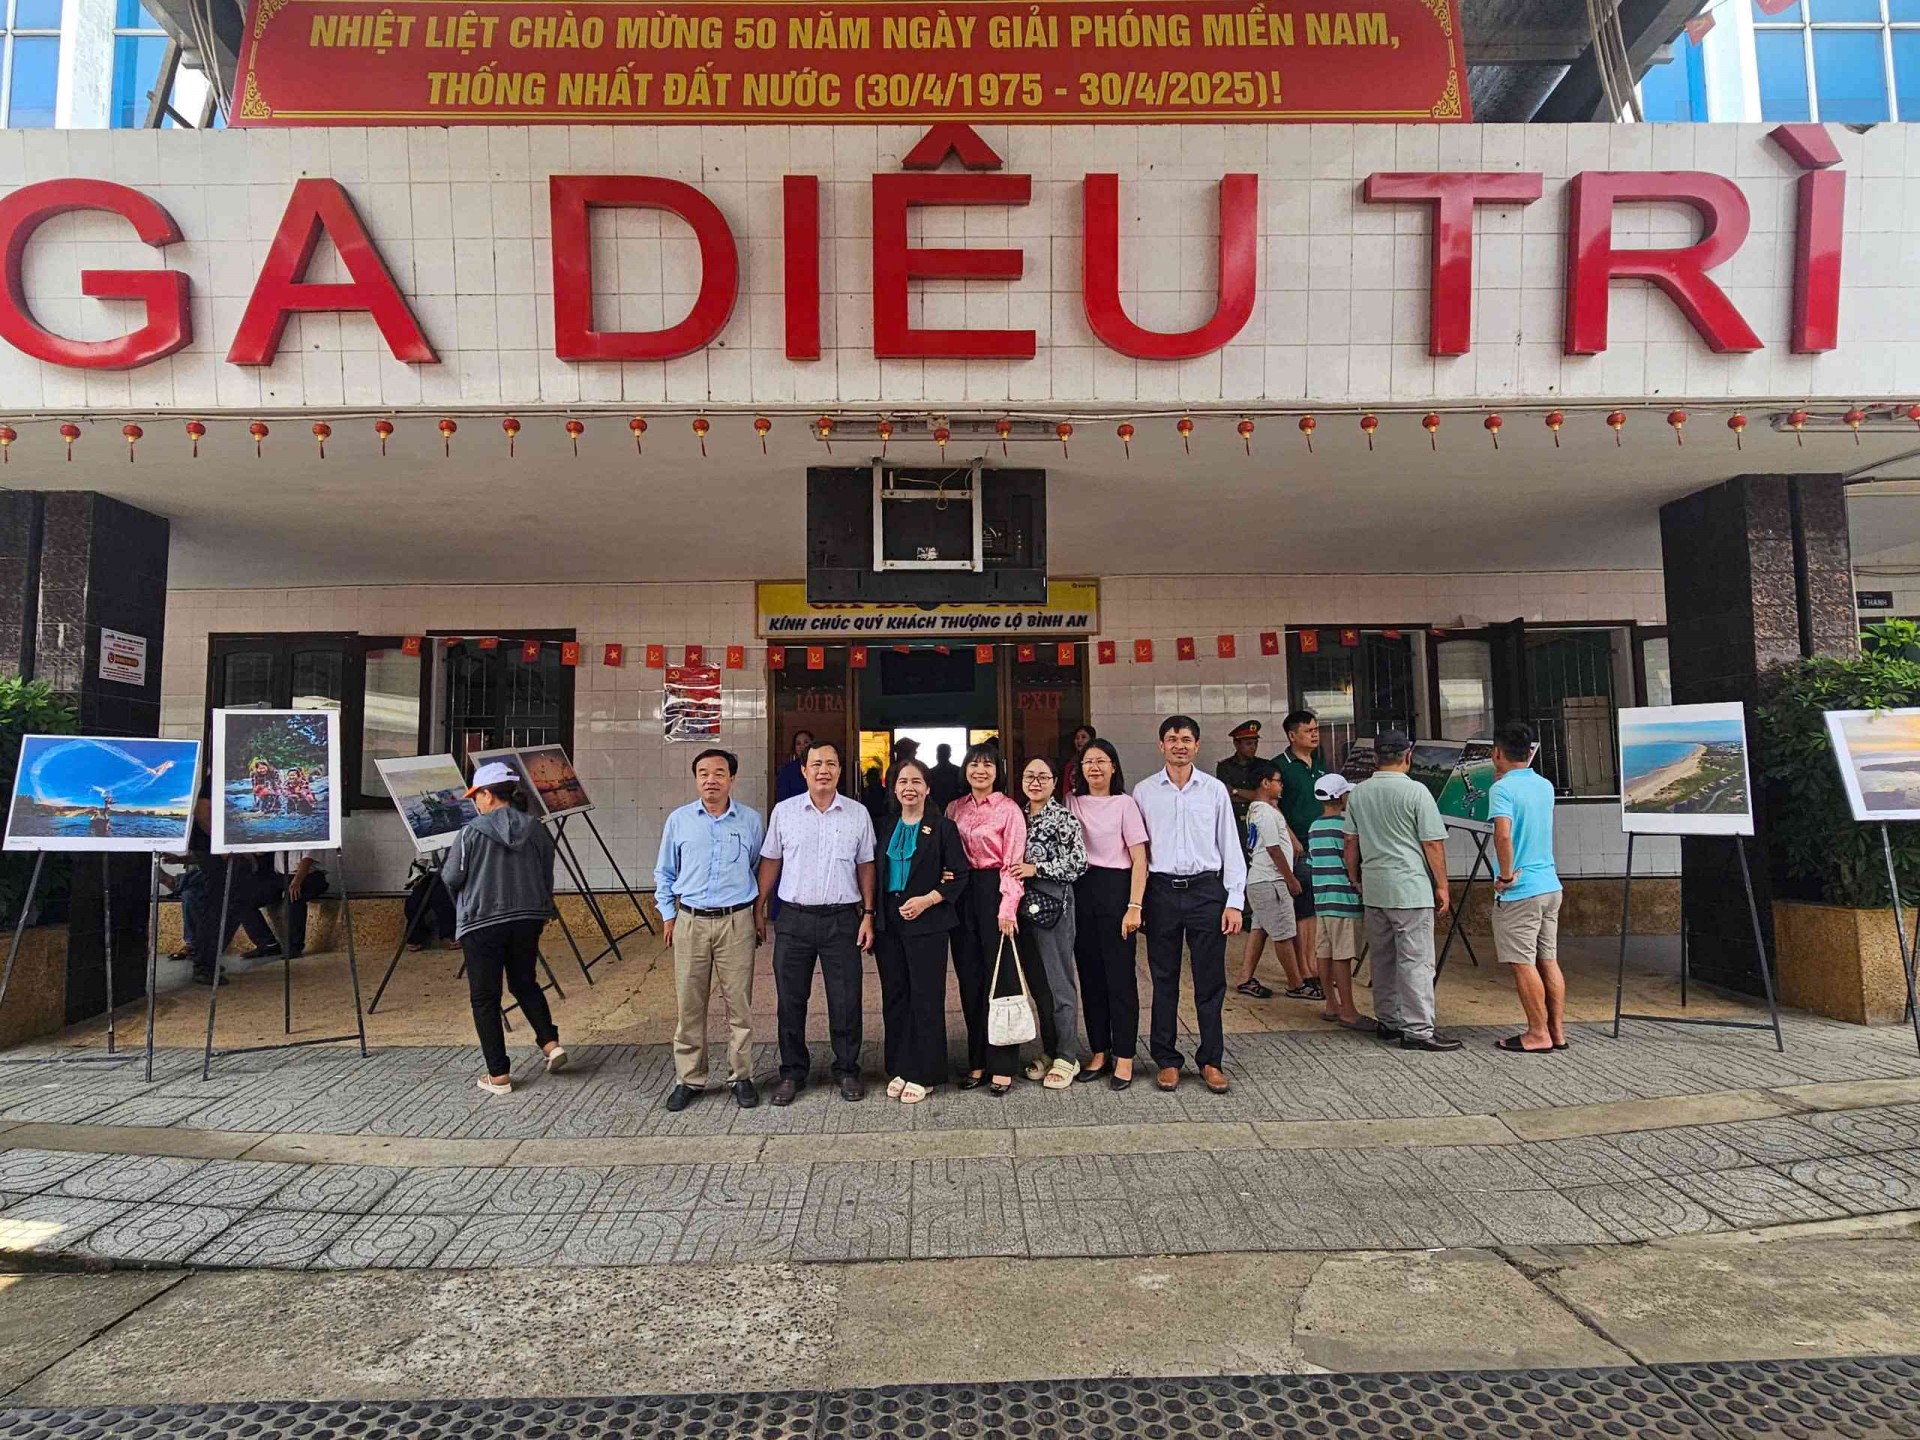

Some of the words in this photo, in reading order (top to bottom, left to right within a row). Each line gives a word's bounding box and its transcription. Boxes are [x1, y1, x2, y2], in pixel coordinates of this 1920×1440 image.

[310, 9, 416, 54] NHIỆT
[425, 10, 499, 55] LIỆT
[509, 10, 604, 48] CHÀO
[616, 10, 722, 49] MỪNG
[734, 17, 777, 49] 50
[788, 11, 870, 49] NĂM
[883, 9, 977, 49] NGÀY
[989, 5, 1058, 48] GIẢI
[1070, 8, 1191, 48] PHÓNG
[1202, 3, 1295, 47] MIỀN
[1305, 12, 1399, 49] NAM,
[427, 60, 546, 105] THỐNG
[557, 61, 653, 106] NHẤT
[663, 61, 732, 106] ĐẤT
[743, 66, 841, 107] NƯỚC
[855, 72, 1042, 110] (30/4/1975
[1055, 86, 1067, 96] -
[1079, 71, 1281, 108] 30/4/2025)!
[0, 177, 441, 371] GA
[549, 124, 1258, 363] DIÊU
[1364, 123, 1846, 357] TRÌ
[768, 615, 807, 631] KÍNH
[811, 614, 850, 630] CHÚC
[854, 614, 884, 630] QUÝ
[886, 614, 937, 630] KHÁCH
[940, 613, 1001, 631] THƯỢNG
[1004, 612, 1022, 631] LỘ
[1026, 611, 1063, 628] BÌNH
[1066, 615, 1088, 627] AN
[824, 694, 845, 711] RA
[1017, 691, 1062, 710] EXIT
